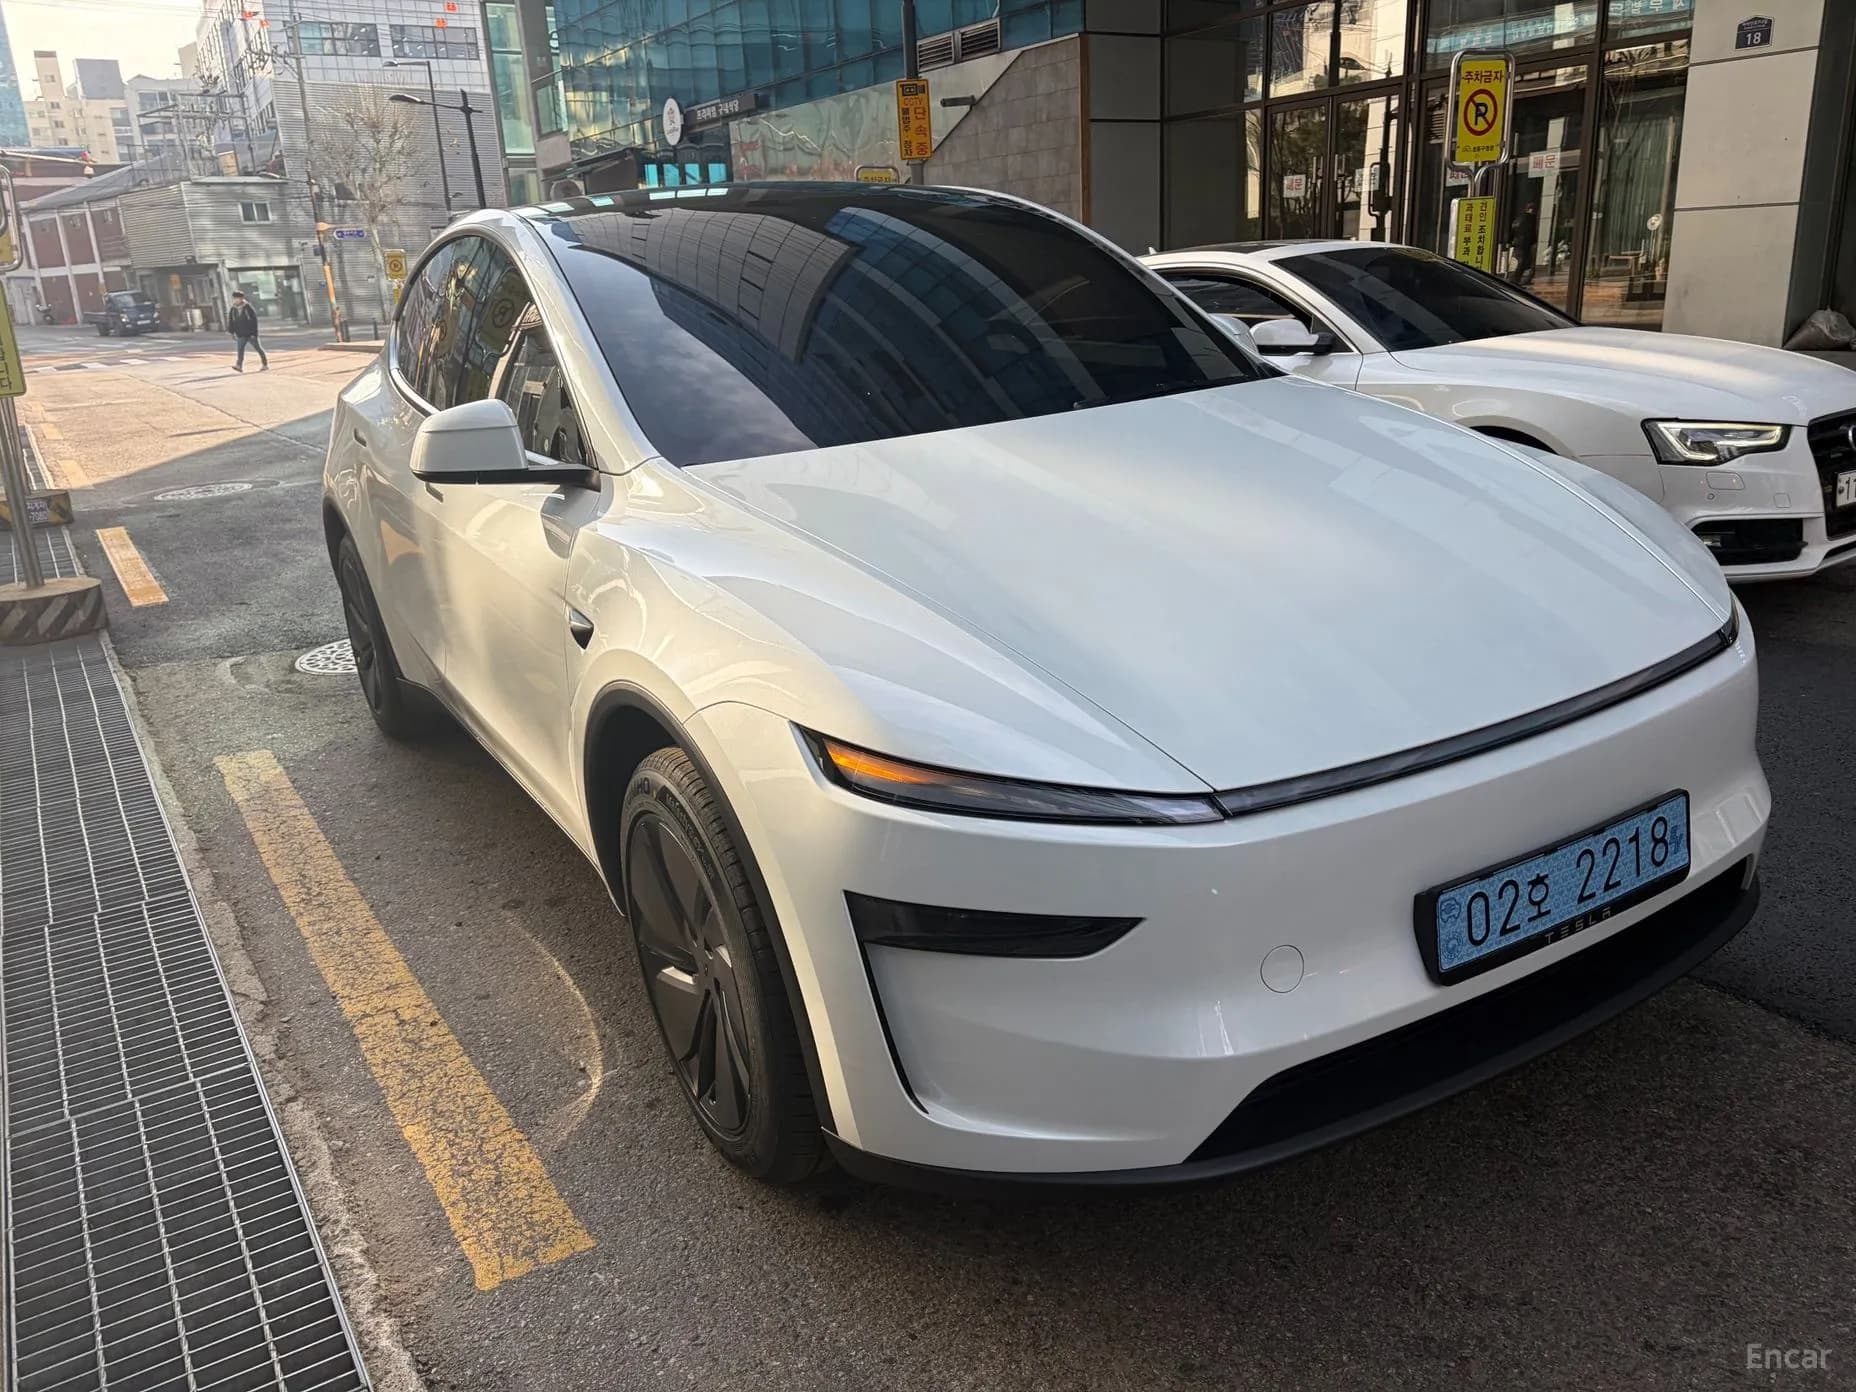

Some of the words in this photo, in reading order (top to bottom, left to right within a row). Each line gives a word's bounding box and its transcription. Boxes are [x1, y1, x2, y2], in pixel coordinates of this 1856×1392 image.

[1746, 32, 1761, 45] 18
[1466, 872, 1551, 947] 02호
[1575, 815, 1669, 905] 2218
[1544, 906, 1612, 944] TESLA
